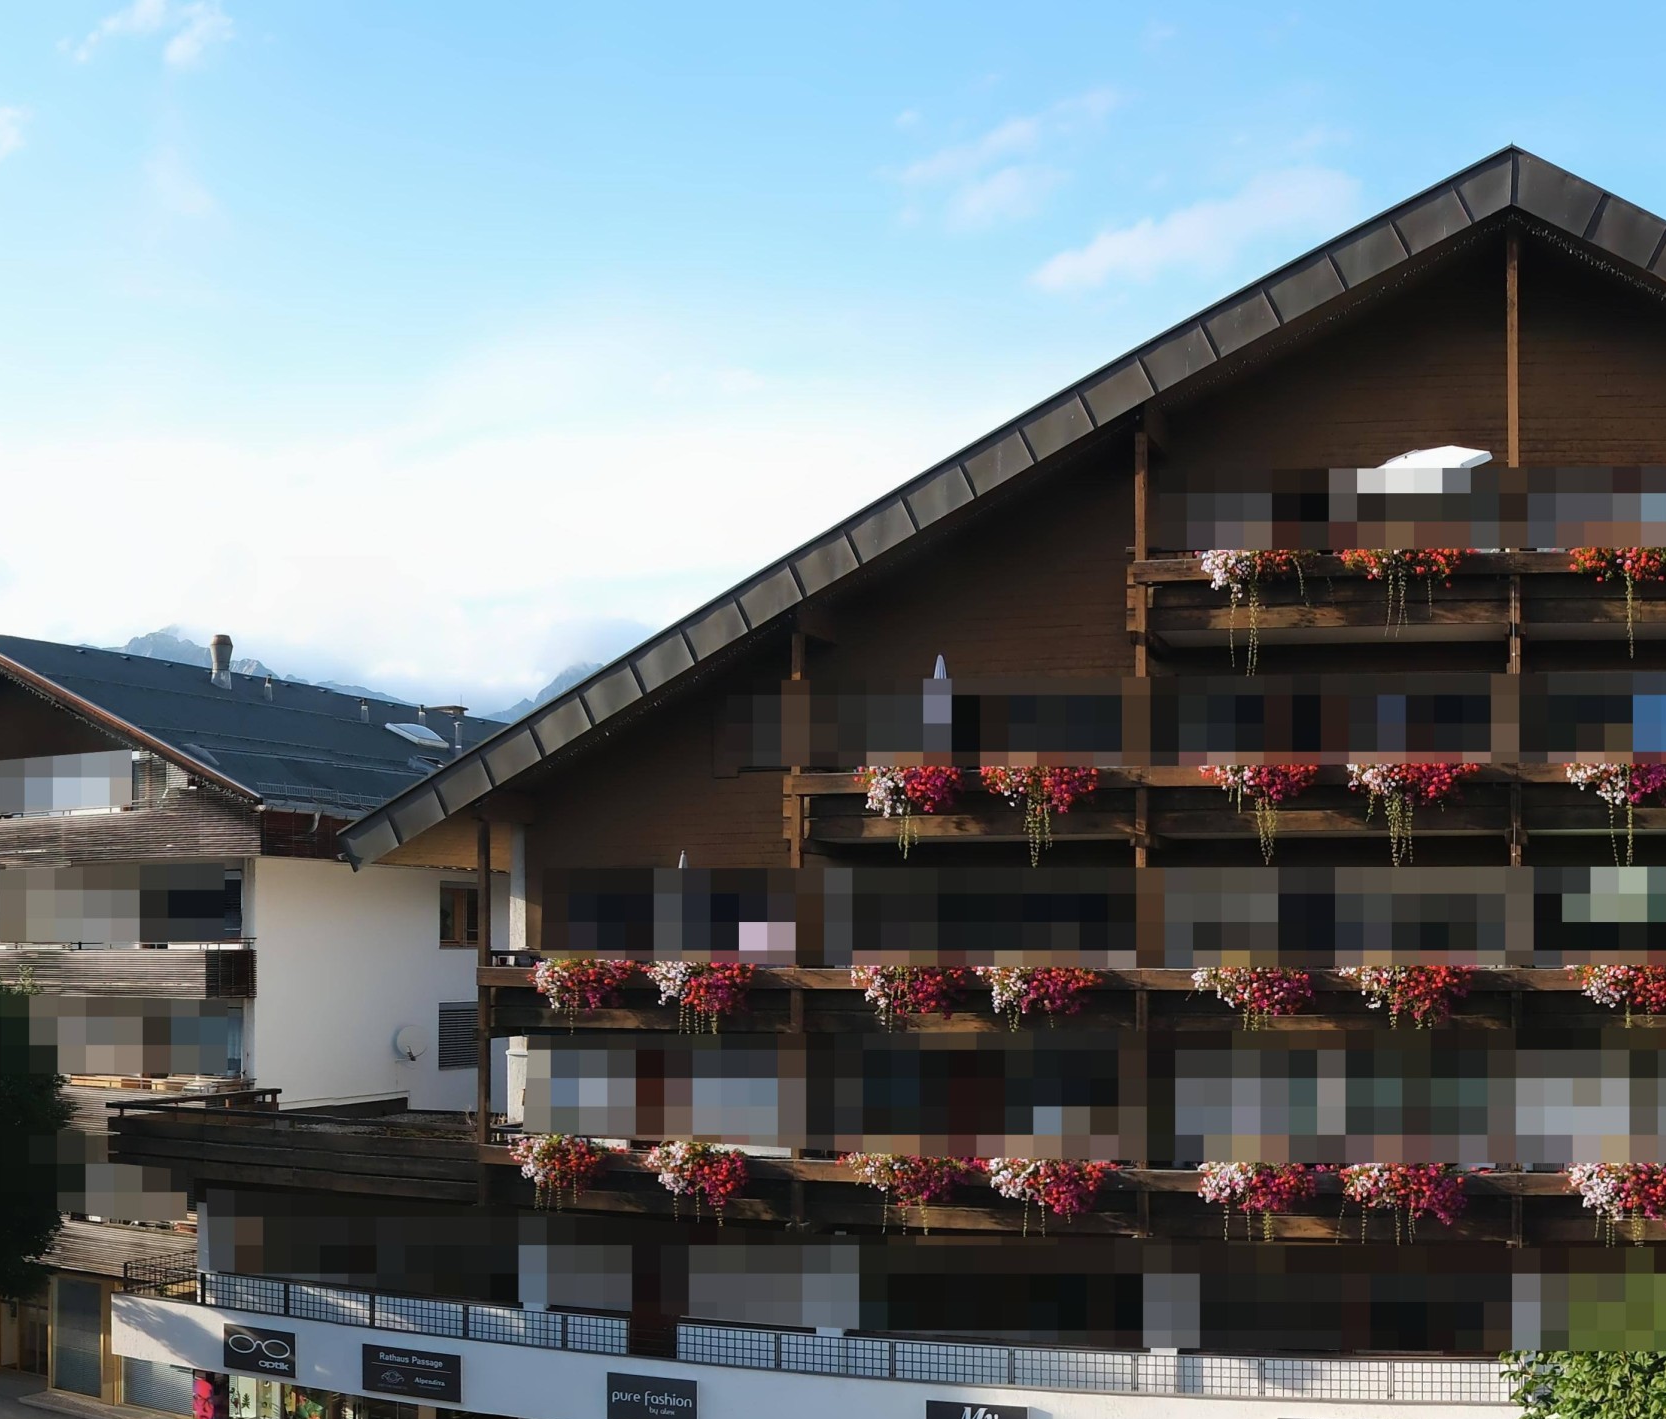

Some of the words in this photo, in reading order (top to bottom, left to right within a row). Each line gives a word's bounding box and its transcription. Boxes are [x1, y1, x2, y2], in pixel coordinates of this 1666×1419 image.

[258, 1360, 289, 1371] optik
[379, 1352, 410, 1364] Rathaus
[412, 1355, 443, 1368] Passage
[612, 1391, 641, 1403] pure
[644, 1391, 692, 1408] fashion
[649, 1406, 659, 1416] by
